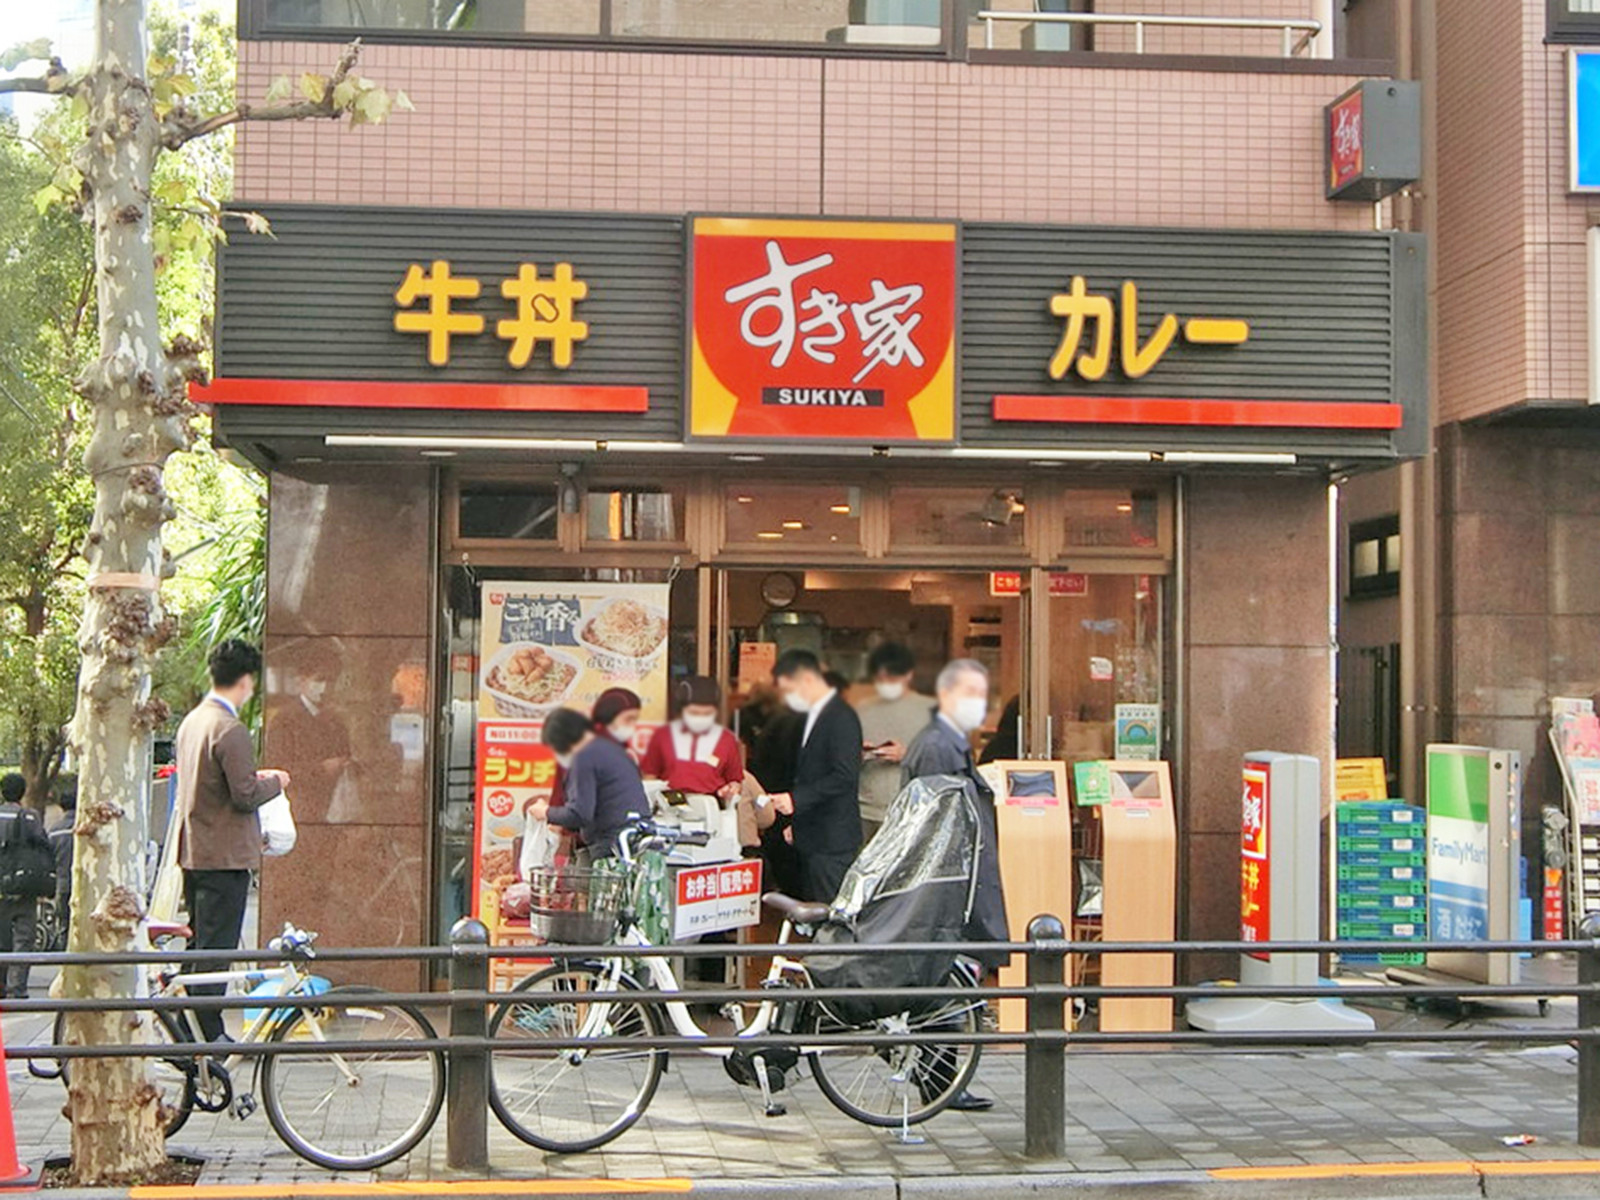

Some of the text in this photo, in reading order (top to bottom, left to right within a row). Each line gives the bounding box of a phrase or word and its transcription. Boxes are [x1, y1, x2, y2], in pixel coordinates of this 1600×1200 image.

[394, 260, 590, 369] 牛丼
[724, 240, 925, 384] すき家
[1049, 275, 1249, 381] カレー
[778, 388, 868, 407] SUKIYA
[485, 757, 556, 784] ランチ
